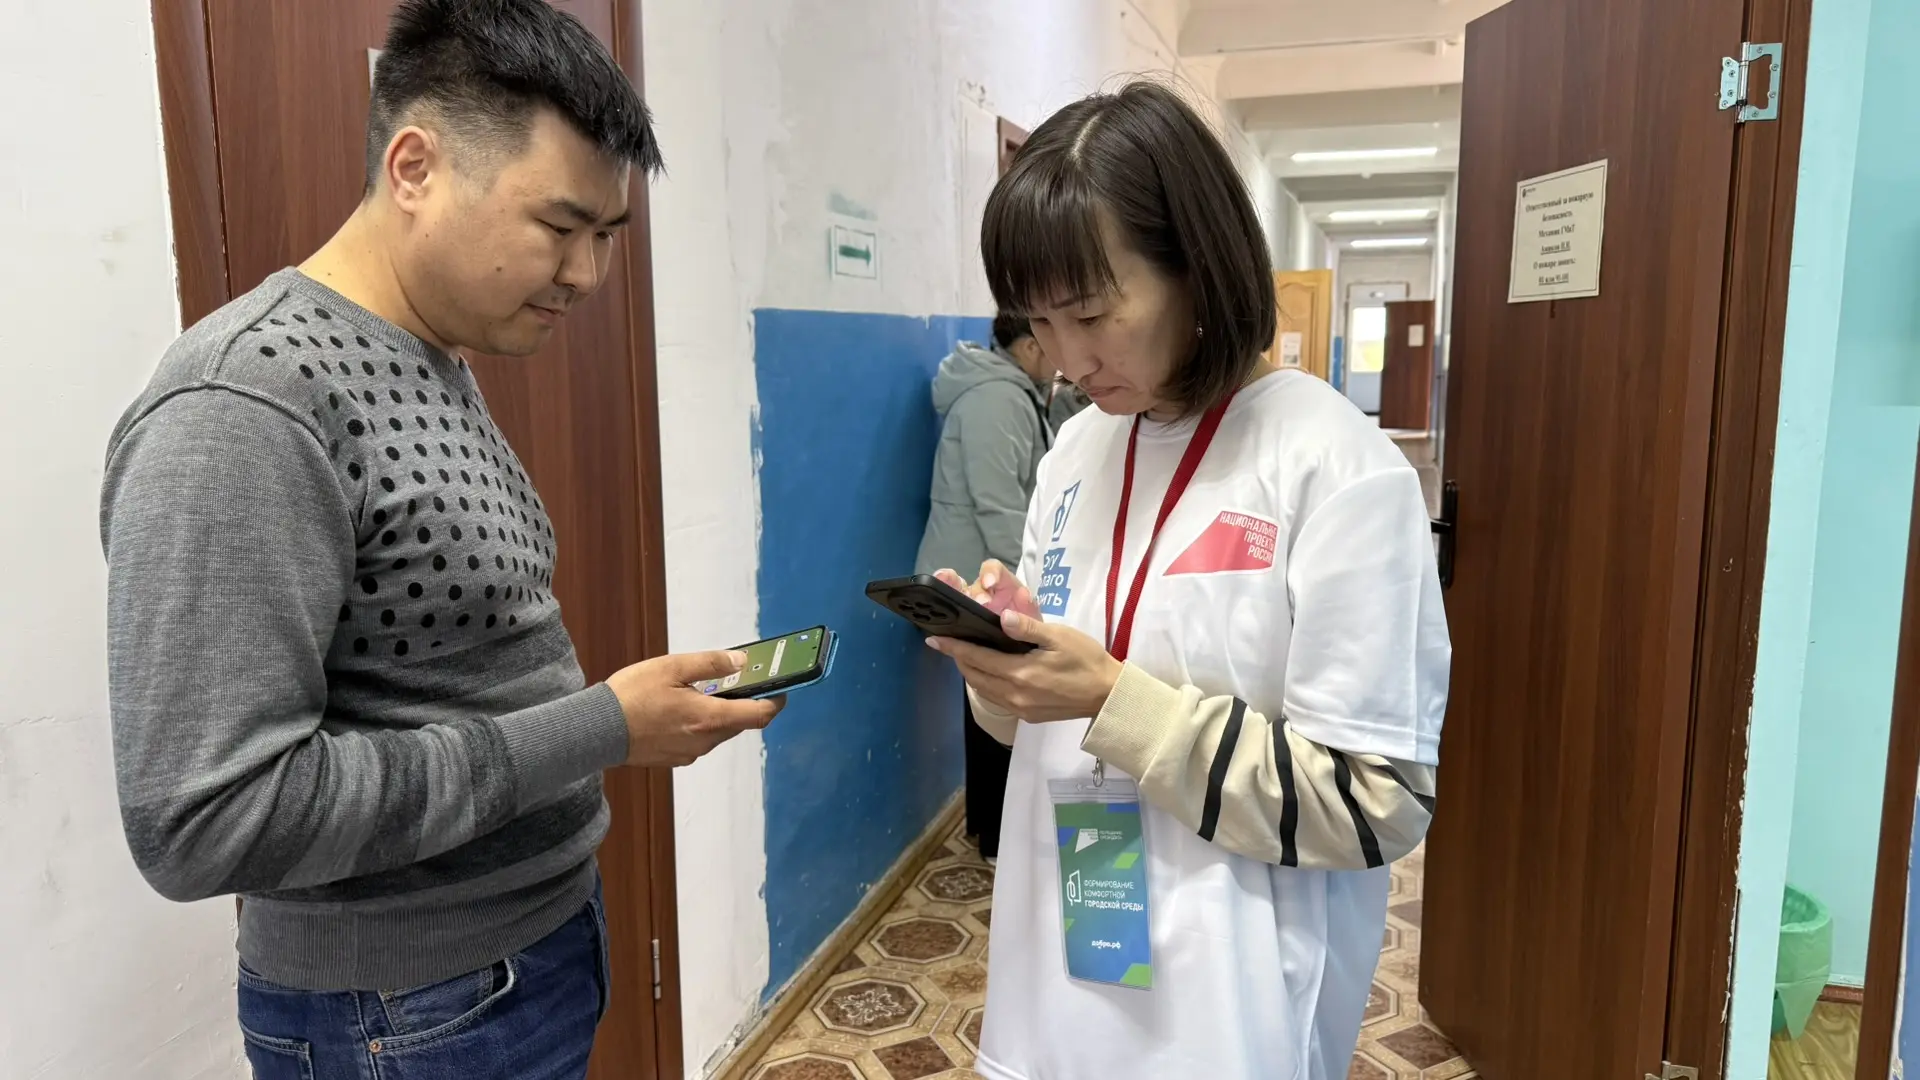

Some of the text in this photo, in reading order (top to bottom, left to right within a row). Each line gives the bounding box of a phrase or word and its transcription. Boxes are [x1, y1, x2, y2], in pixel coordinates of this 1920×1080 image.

[1084, 880, 1134, 890] ФОРМИРОВАНИЕ
[1084, 890, 1126, 899] КОМФОРТНОЙ
[1085, 900, 1143, 912] ГОРОДСКОЙ СРЕДЫ
